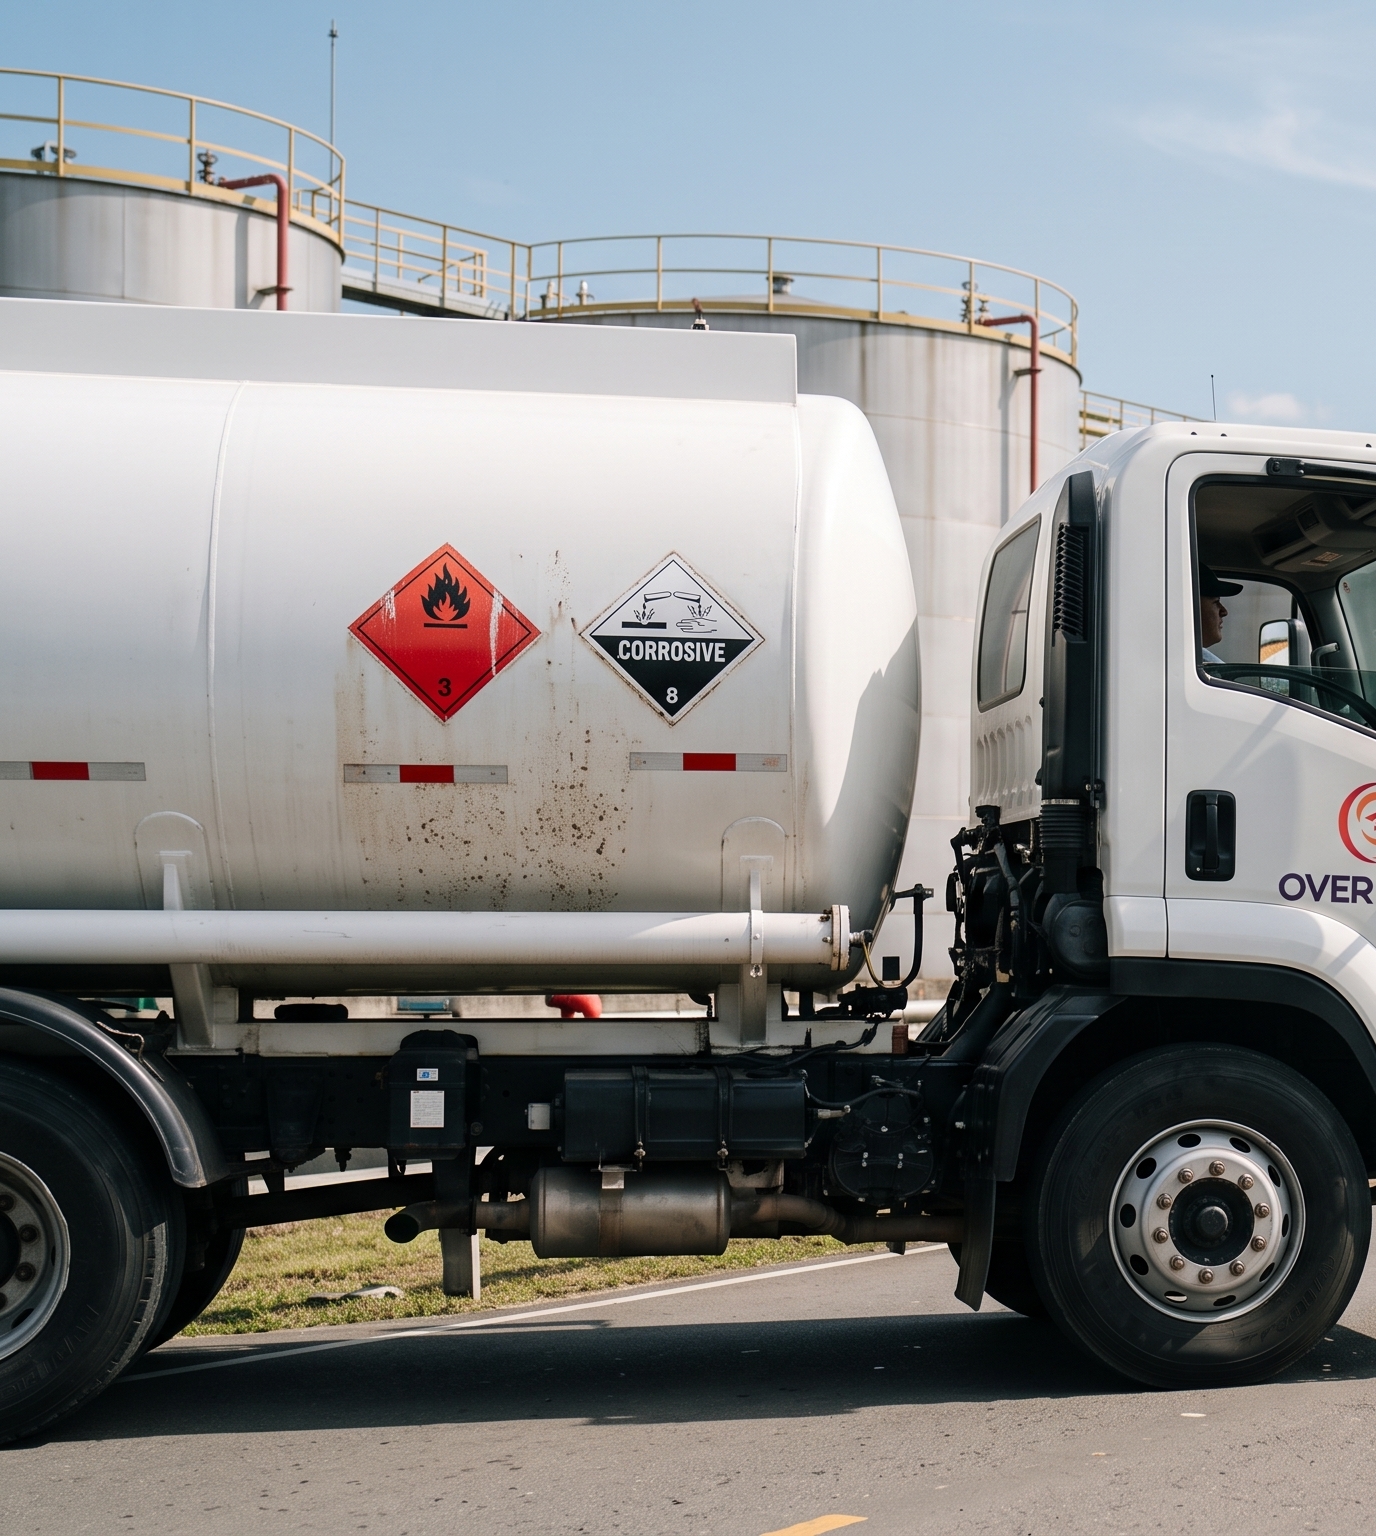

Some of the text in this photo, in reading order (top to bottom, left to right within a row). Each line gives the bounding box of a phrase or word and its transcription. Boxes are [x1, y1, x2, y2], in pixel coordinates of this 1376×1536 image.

[618, 639, 726, 663] CORROSIVE
[437, 677, 452, 697] 3
[665, 686, 679, 704] 8
[1278, 872, 1374, 905] OVER
